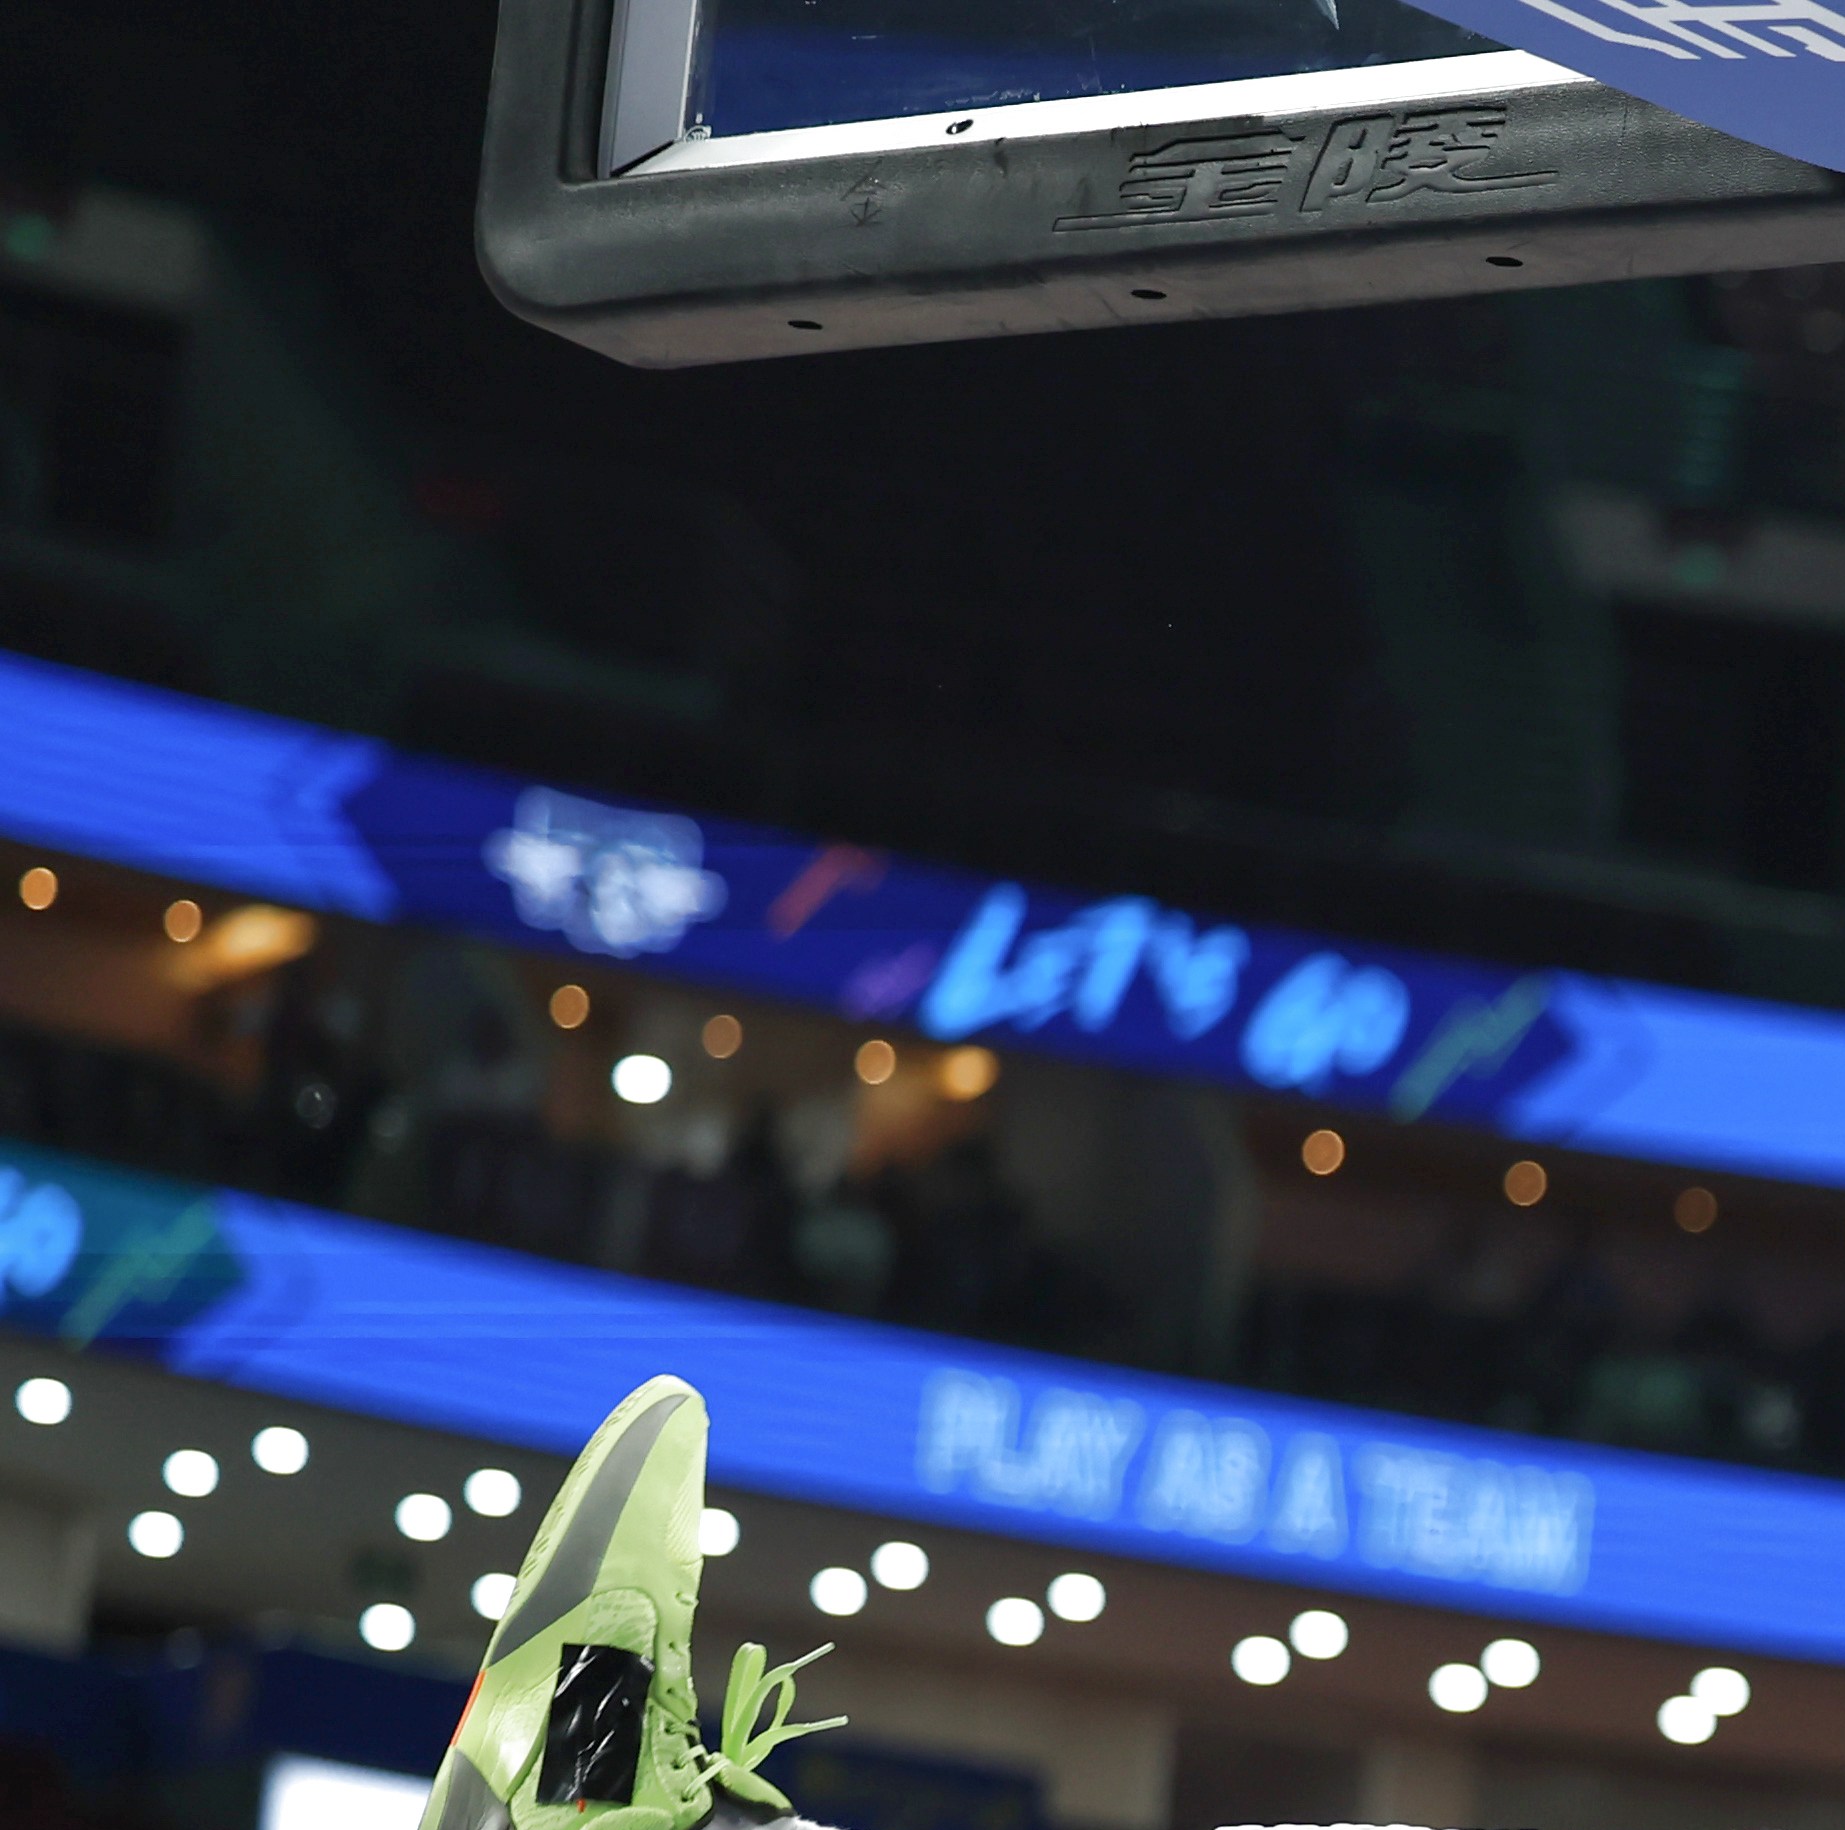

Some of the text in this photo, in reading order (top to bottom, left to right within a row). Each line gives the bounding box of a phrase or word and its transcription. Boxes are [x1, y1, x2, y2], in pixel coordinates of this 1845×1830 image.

[915, 1368, 1596, 1598] PLAY AS A TEAM
